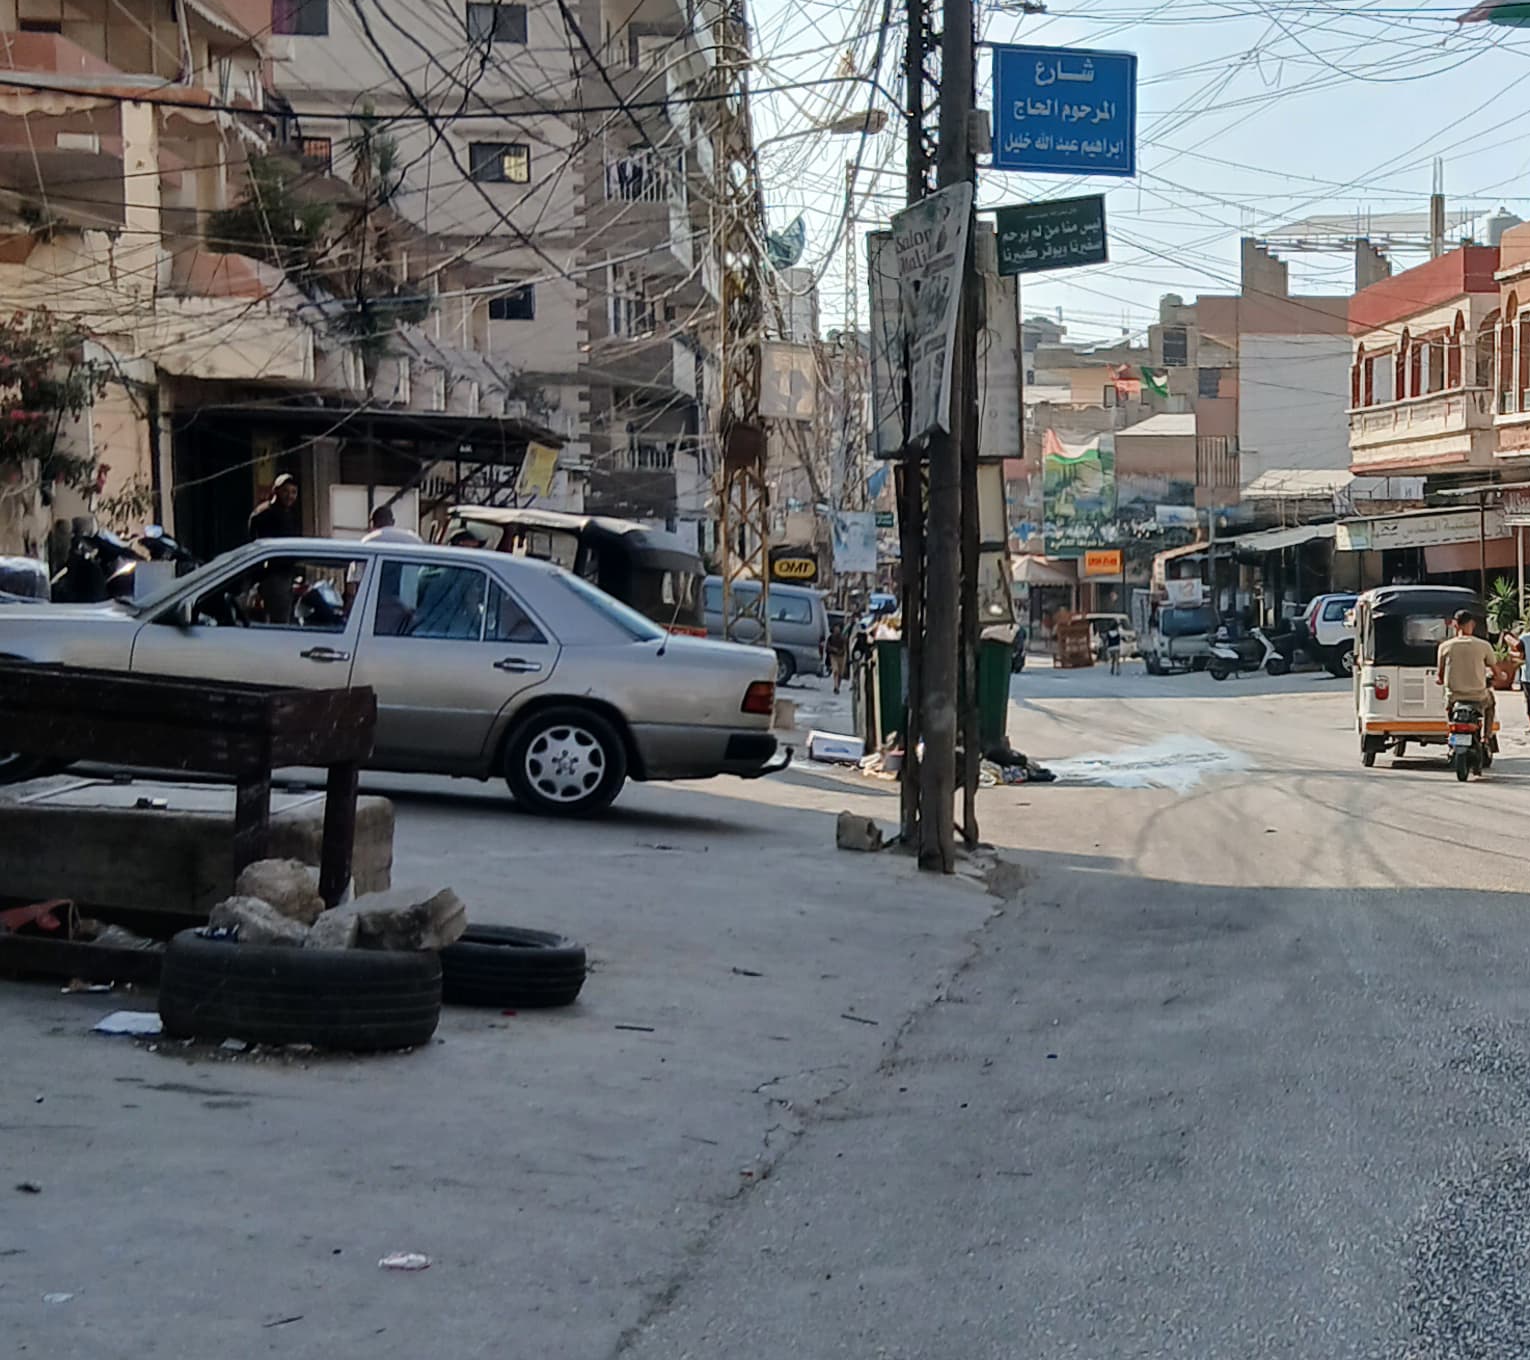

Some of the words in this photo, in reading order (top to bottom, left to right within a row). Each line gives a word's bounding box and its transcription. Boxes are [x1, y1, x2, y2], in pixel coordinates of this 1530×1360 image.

[1034, 57, 1096, 86] شارع
[1013, 96, 1058, 120] الحاج
[1061, 100, 1116, 124] المرحوم
[1004, 131, 1032, 154] خليل
[1034, 131, 1054, 151] الله
[1056, 137, 1079, 157] عبد
[1044, 224, 1060, 240] من
[1061, 220, 1078, 234] منا
[1080, 216, 1102, 236] ليس
[779, 563, 810, 574] OMT
